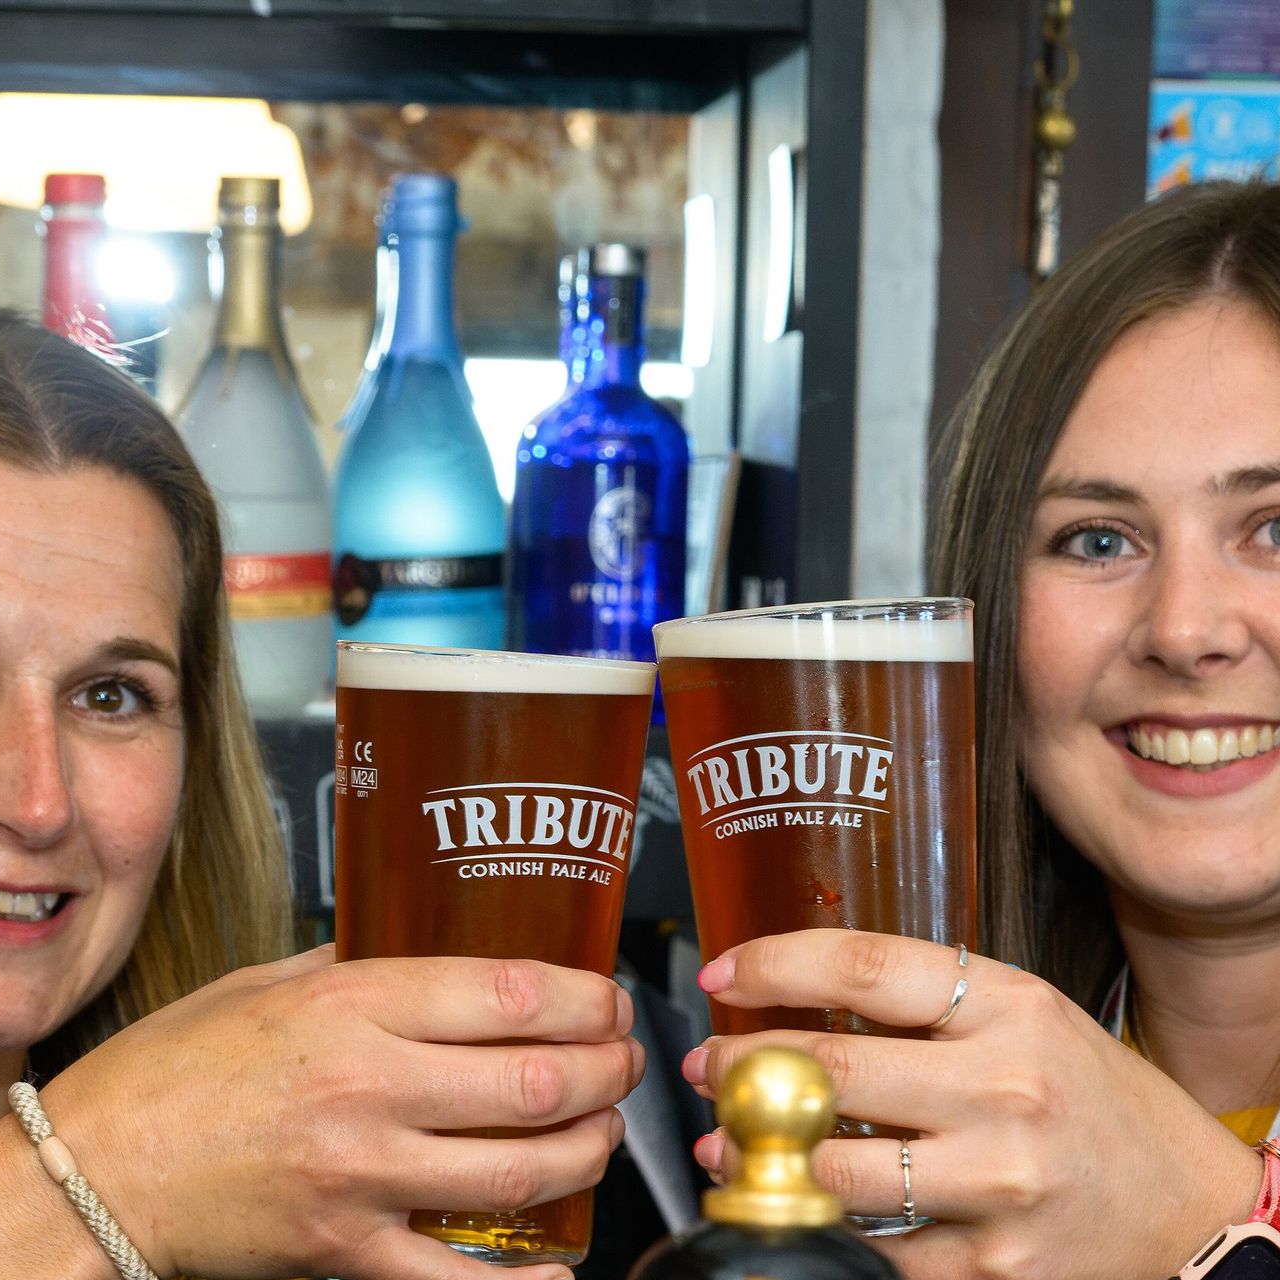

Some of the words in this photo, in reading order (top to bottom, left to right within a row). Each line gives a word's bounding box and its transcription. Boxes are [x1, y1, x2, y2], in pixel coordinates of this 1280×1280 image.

[352, 769, 375, 787] M24
[686, 741, 895, 818] TRIBUTE
[422, 795, 636, 863] TRIBUTE
[714, 812, 780, 842] CORNISH
[783, 811, 825, 830] PALE
[828, 813, 863, 831] ALE
[457, 860, 545, 881] CORNISH
[549, 863, 588, 882] PALE
[588, 870, 612, 886] ALE
